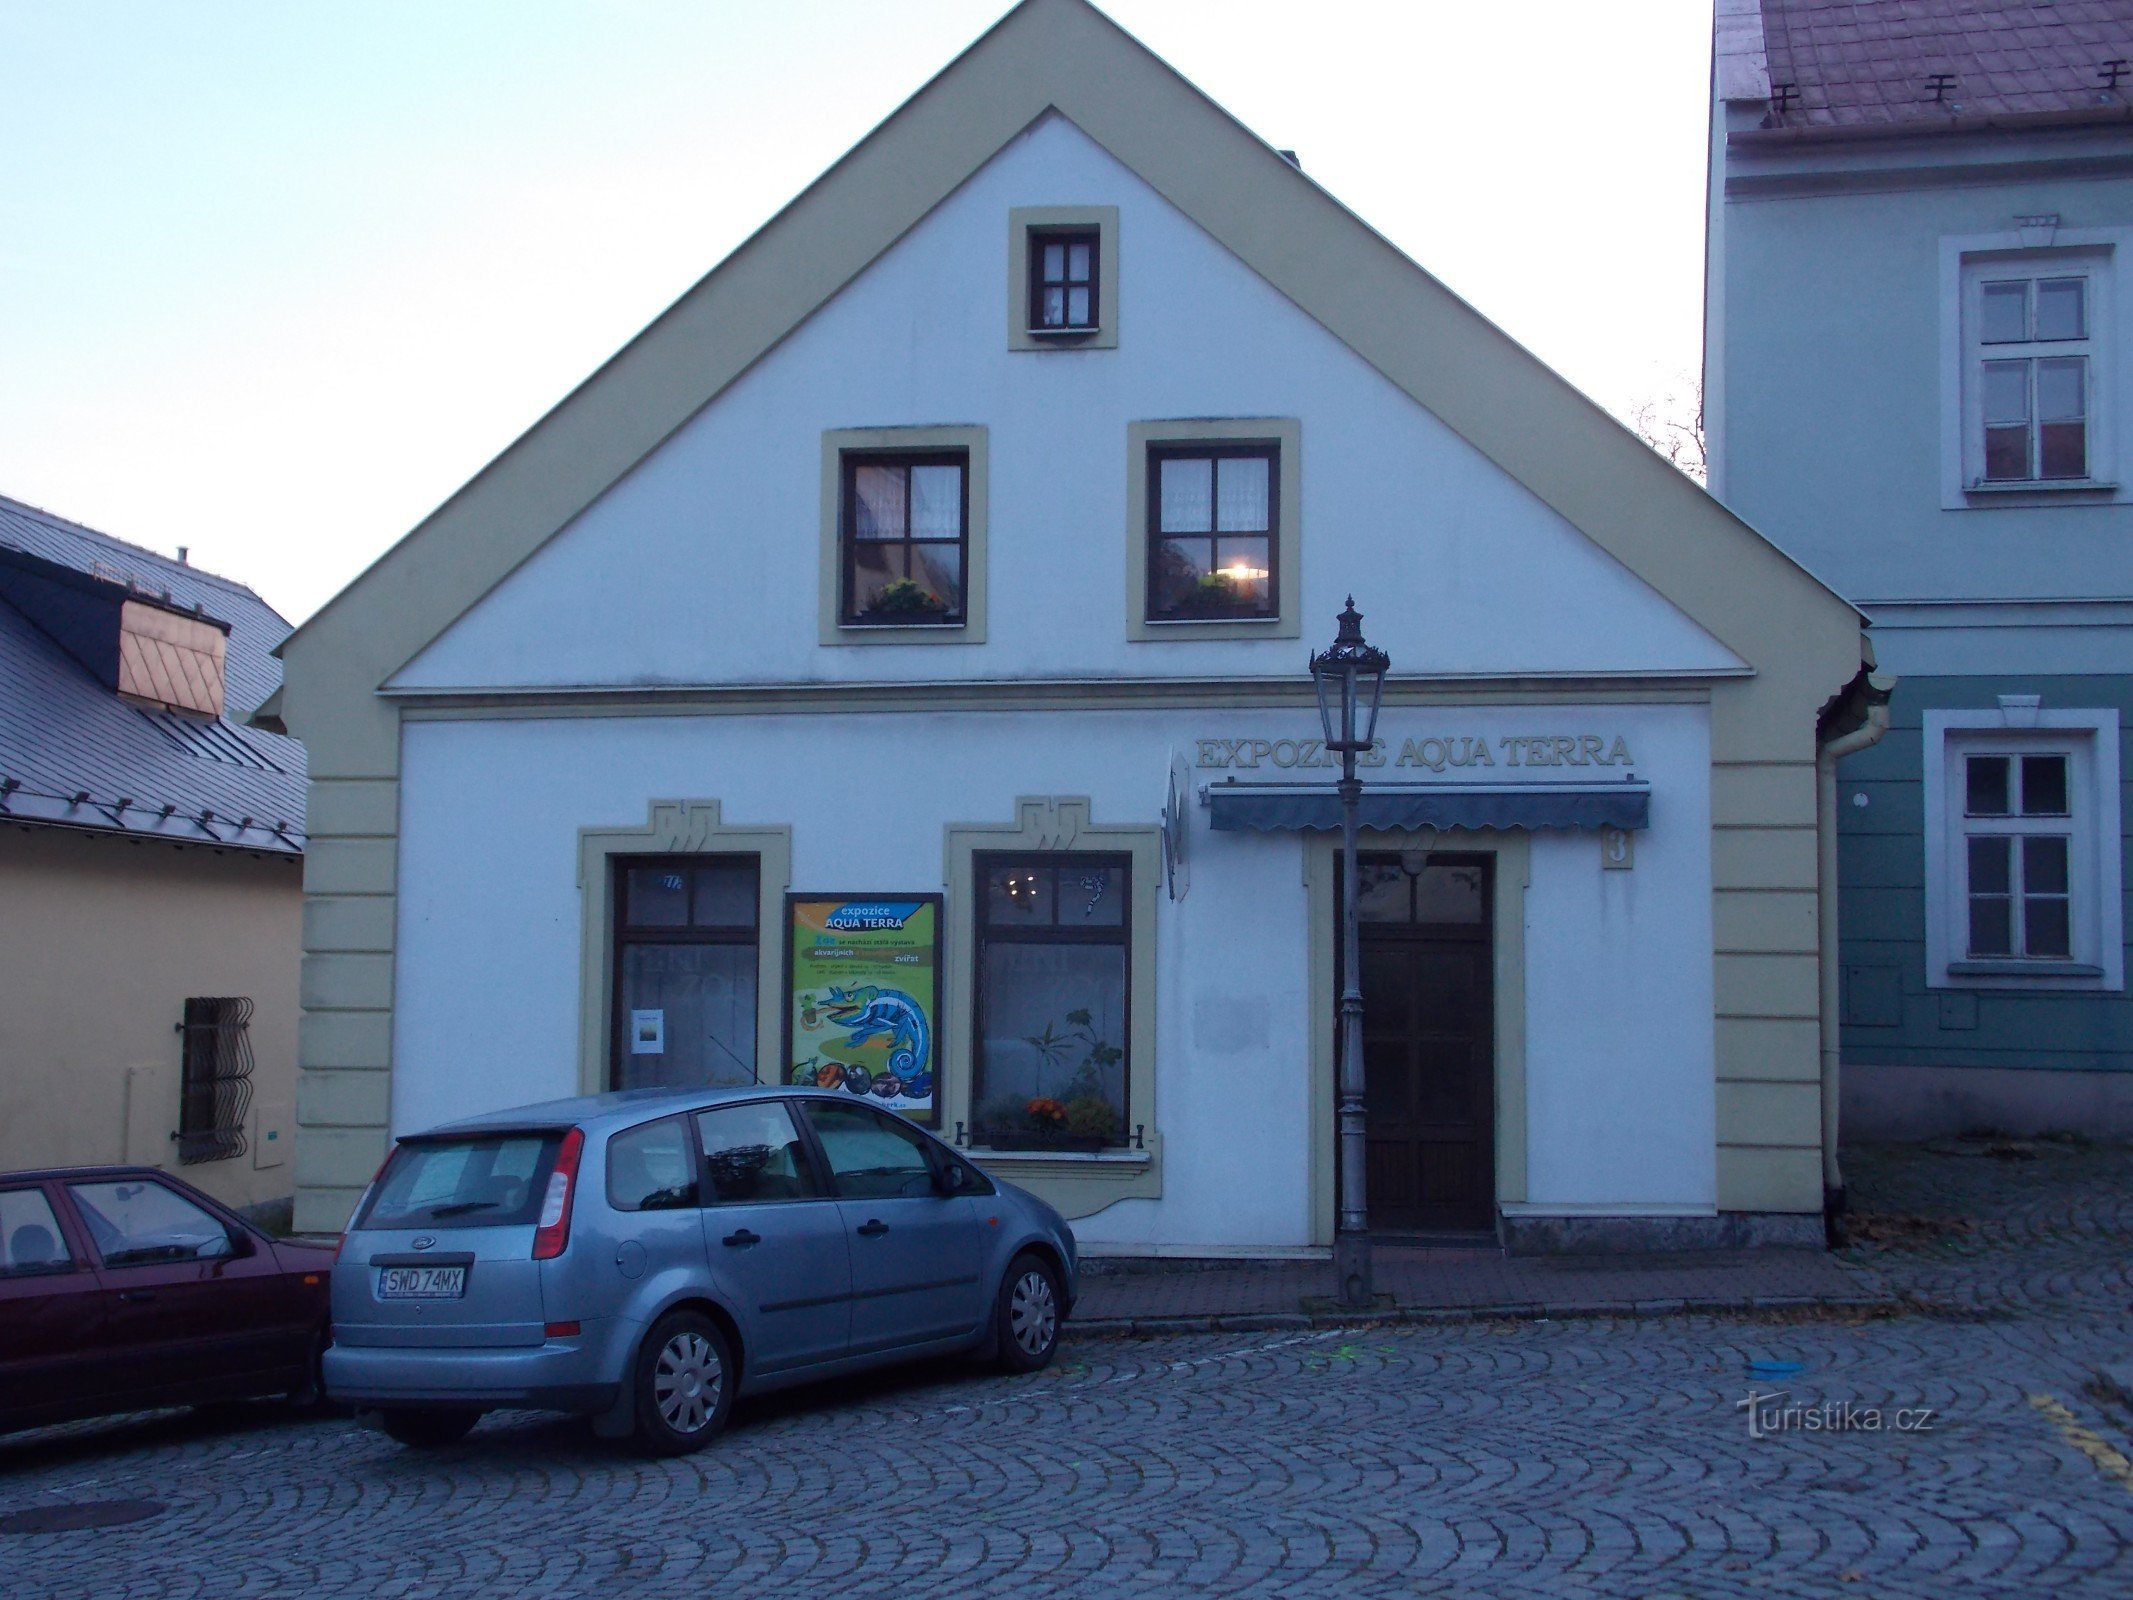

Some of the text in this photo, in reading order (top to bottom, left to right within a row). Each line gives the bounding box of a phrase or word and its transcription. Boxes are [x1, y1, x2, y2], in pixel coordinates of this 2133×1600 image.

[1395, 737, 1495, 772] AQUA
[1500, 735, 1634, 767] TERRA
[1609, 830, 1625, 862] 3
[841, 905, 890, 917] expozice
[825, 918, 903, 930] AQUA TERRA
[388, 1270, 461, 1291] SWD 74MX
